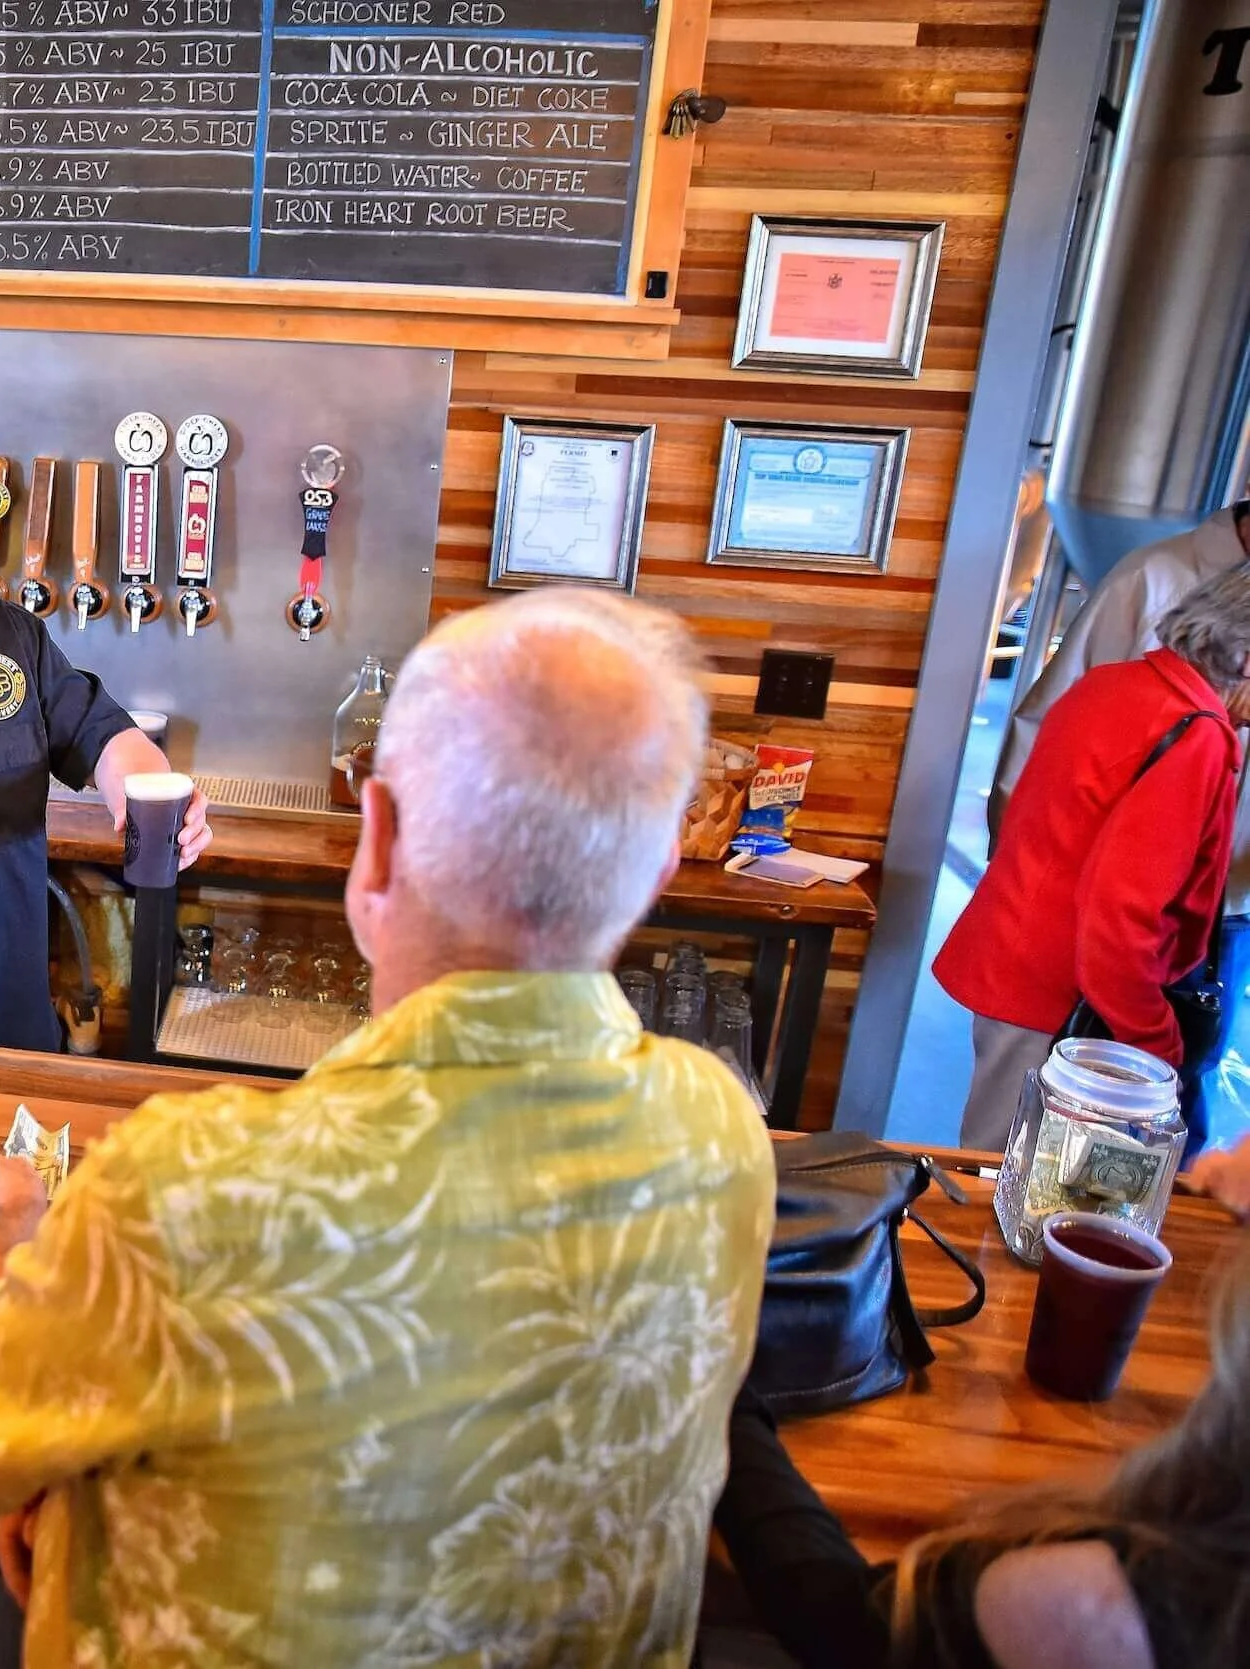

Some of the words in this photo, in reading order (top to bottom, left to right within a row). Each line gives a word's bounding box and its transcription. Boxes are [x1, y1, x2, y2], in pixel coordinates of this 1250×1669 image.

[183, 0, 233, 26] IBU
[287, 1, 432, 25] SCHOONER
[448, 1, 506, 25] RED
[136, 40, 166, 66] 25
[181, 41, 237, 67] IBU
[138, 81, 176, 104] 23
[187, 80, 237, 104] IBU
[472, 86, 525, 108] DIET
[537, 87, 609, 111] COKE
[141, 118, 200, 145] 23.5
[203, 120, 256, 147] IBU
[290, 120, 388, 145] SPRITE
[427, 121, 535, 149] GINGER
[545, 123, 608, 151] ALE
[53, 160, 110, 182] ABV
[287, 162, 381, 187] BOTTLED
[496, 167, 589, 194] COFFEE
[53, 194, 113, 218] ABV
[274, 199, 333, 223] IRON
[344, 201, 415, 225] HEART
[425, 202, 487, 226] ROOT
[496, 204, 575, 232] BEER
[57, 234, 123, 260] ABV
[753, 772, 805, 788] DAVID
